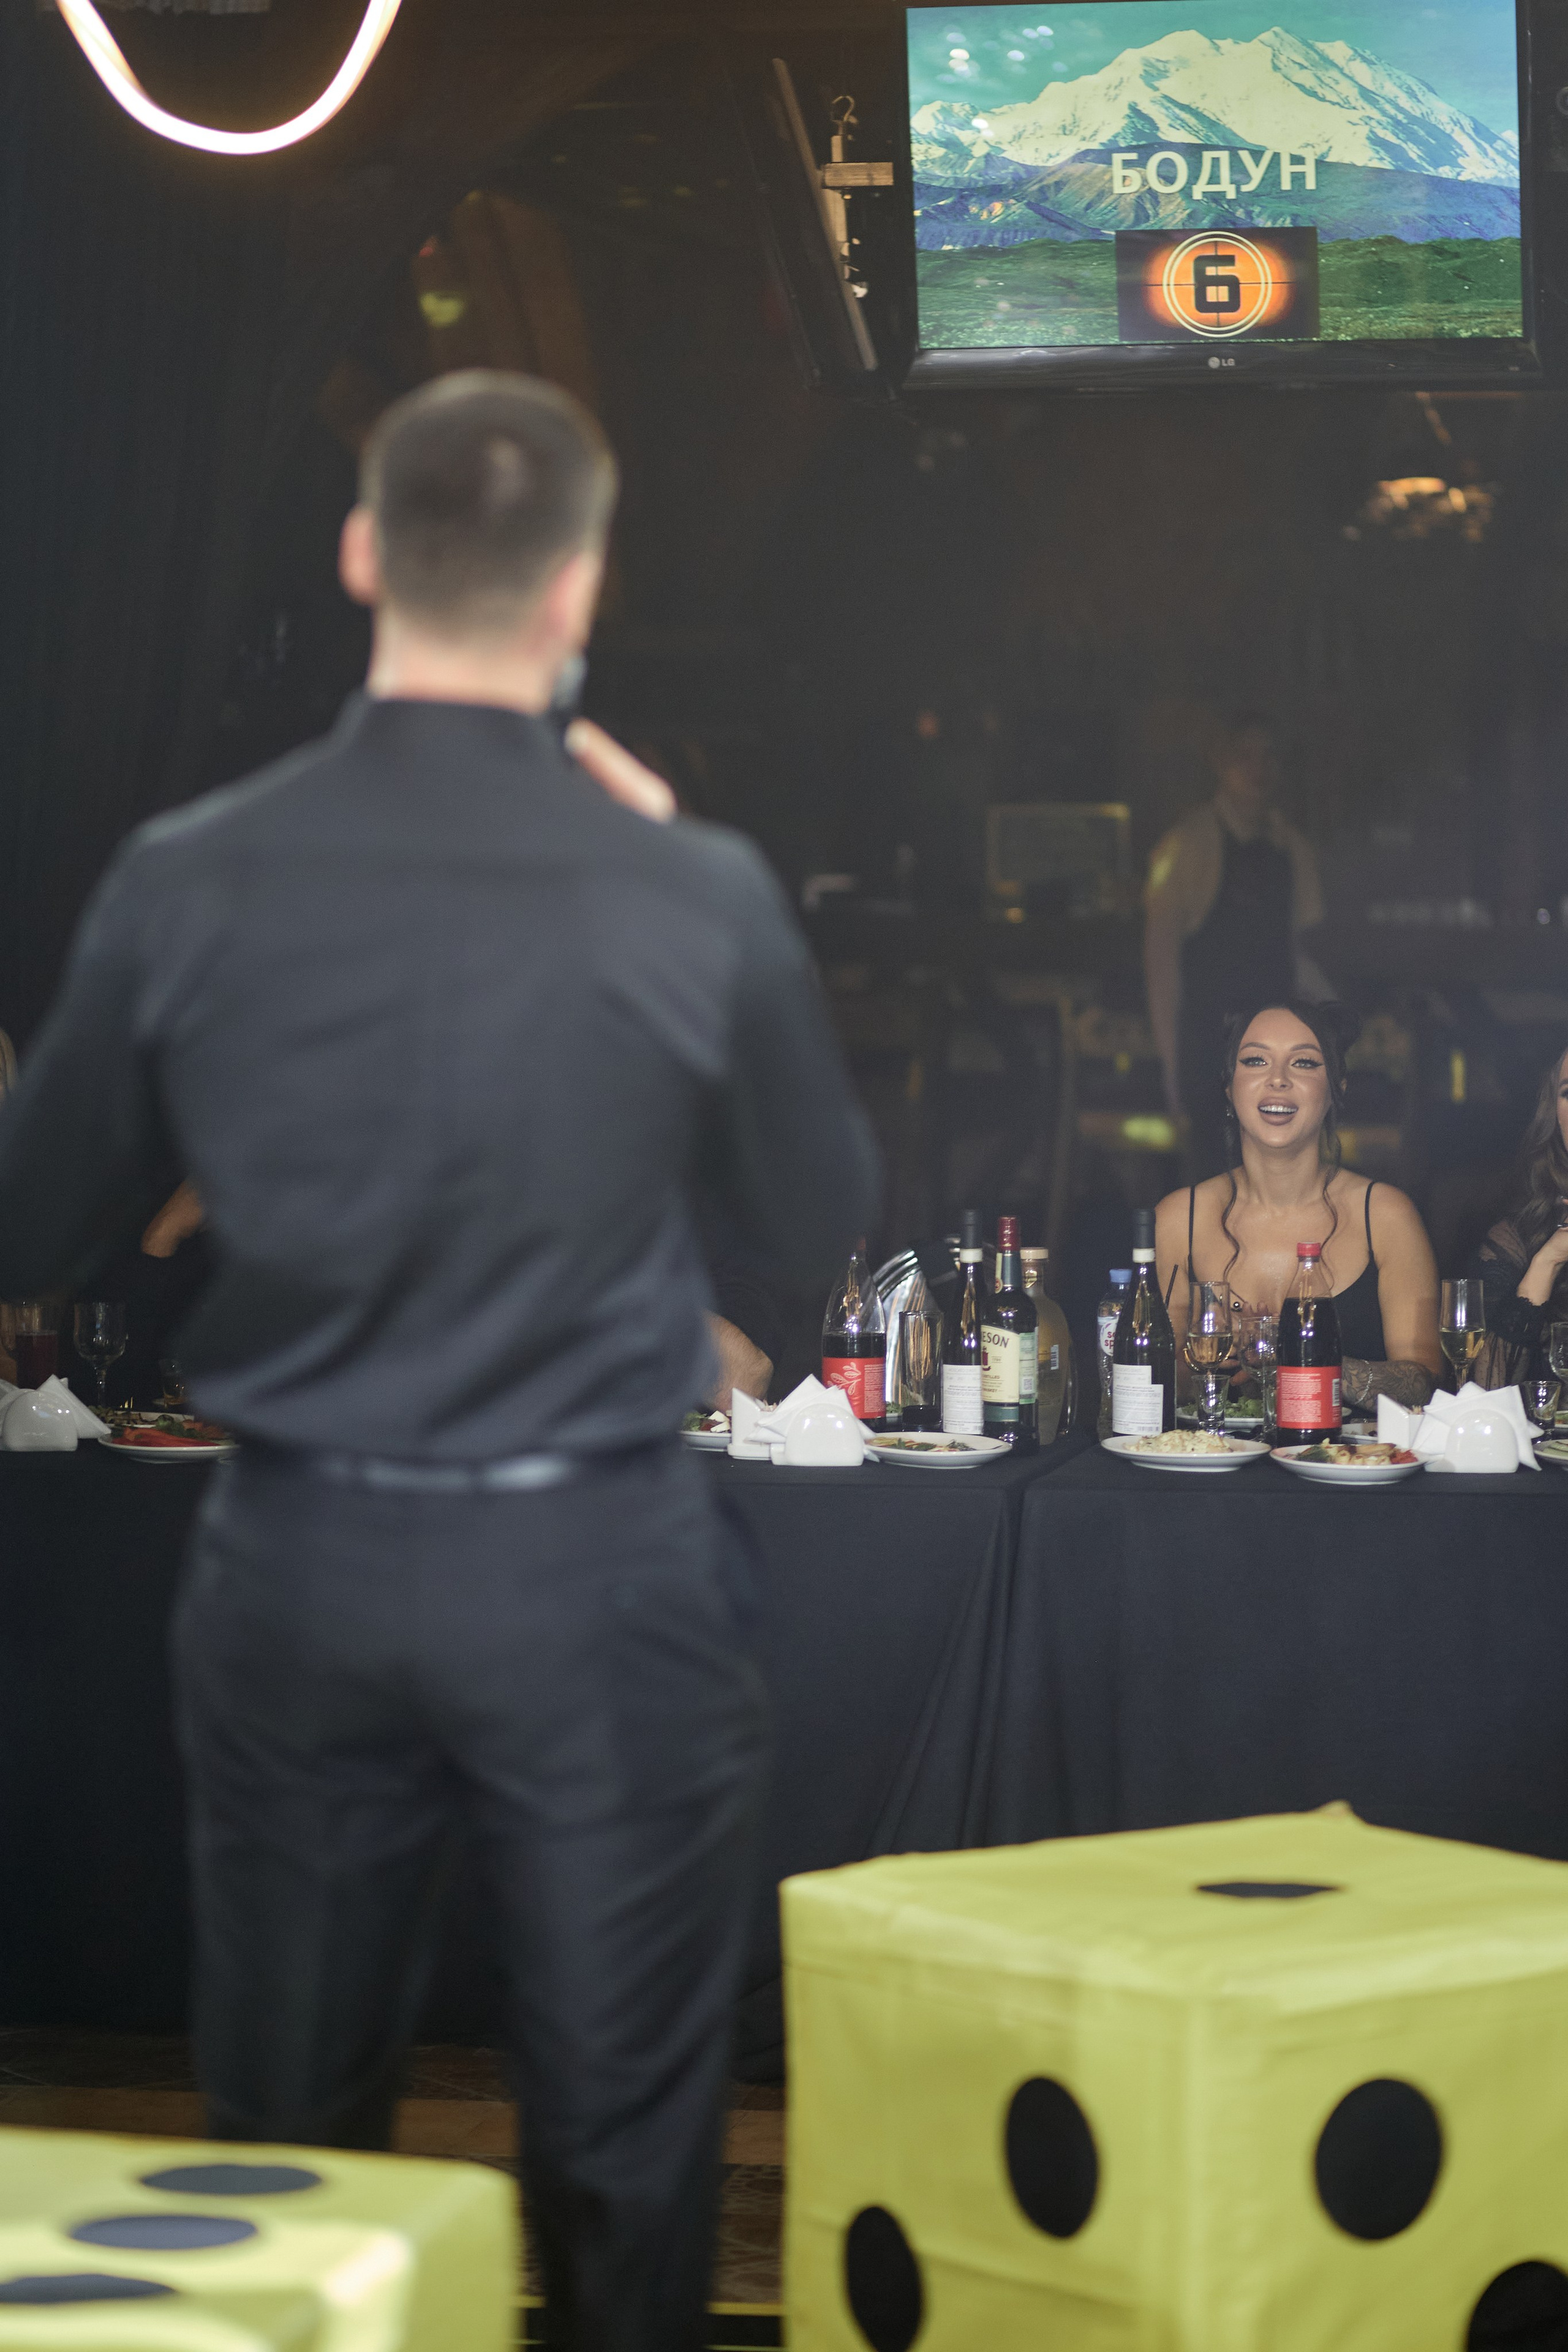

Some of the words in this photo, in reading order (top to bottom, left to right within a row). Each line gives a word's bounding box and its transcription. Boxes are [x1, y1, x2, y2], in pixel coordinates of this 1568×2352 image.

[1112, 149, 1317, 200] БОДУН
[1193, 254, 1241, 313] 6
[1221, 358, 1235, 366] LG
